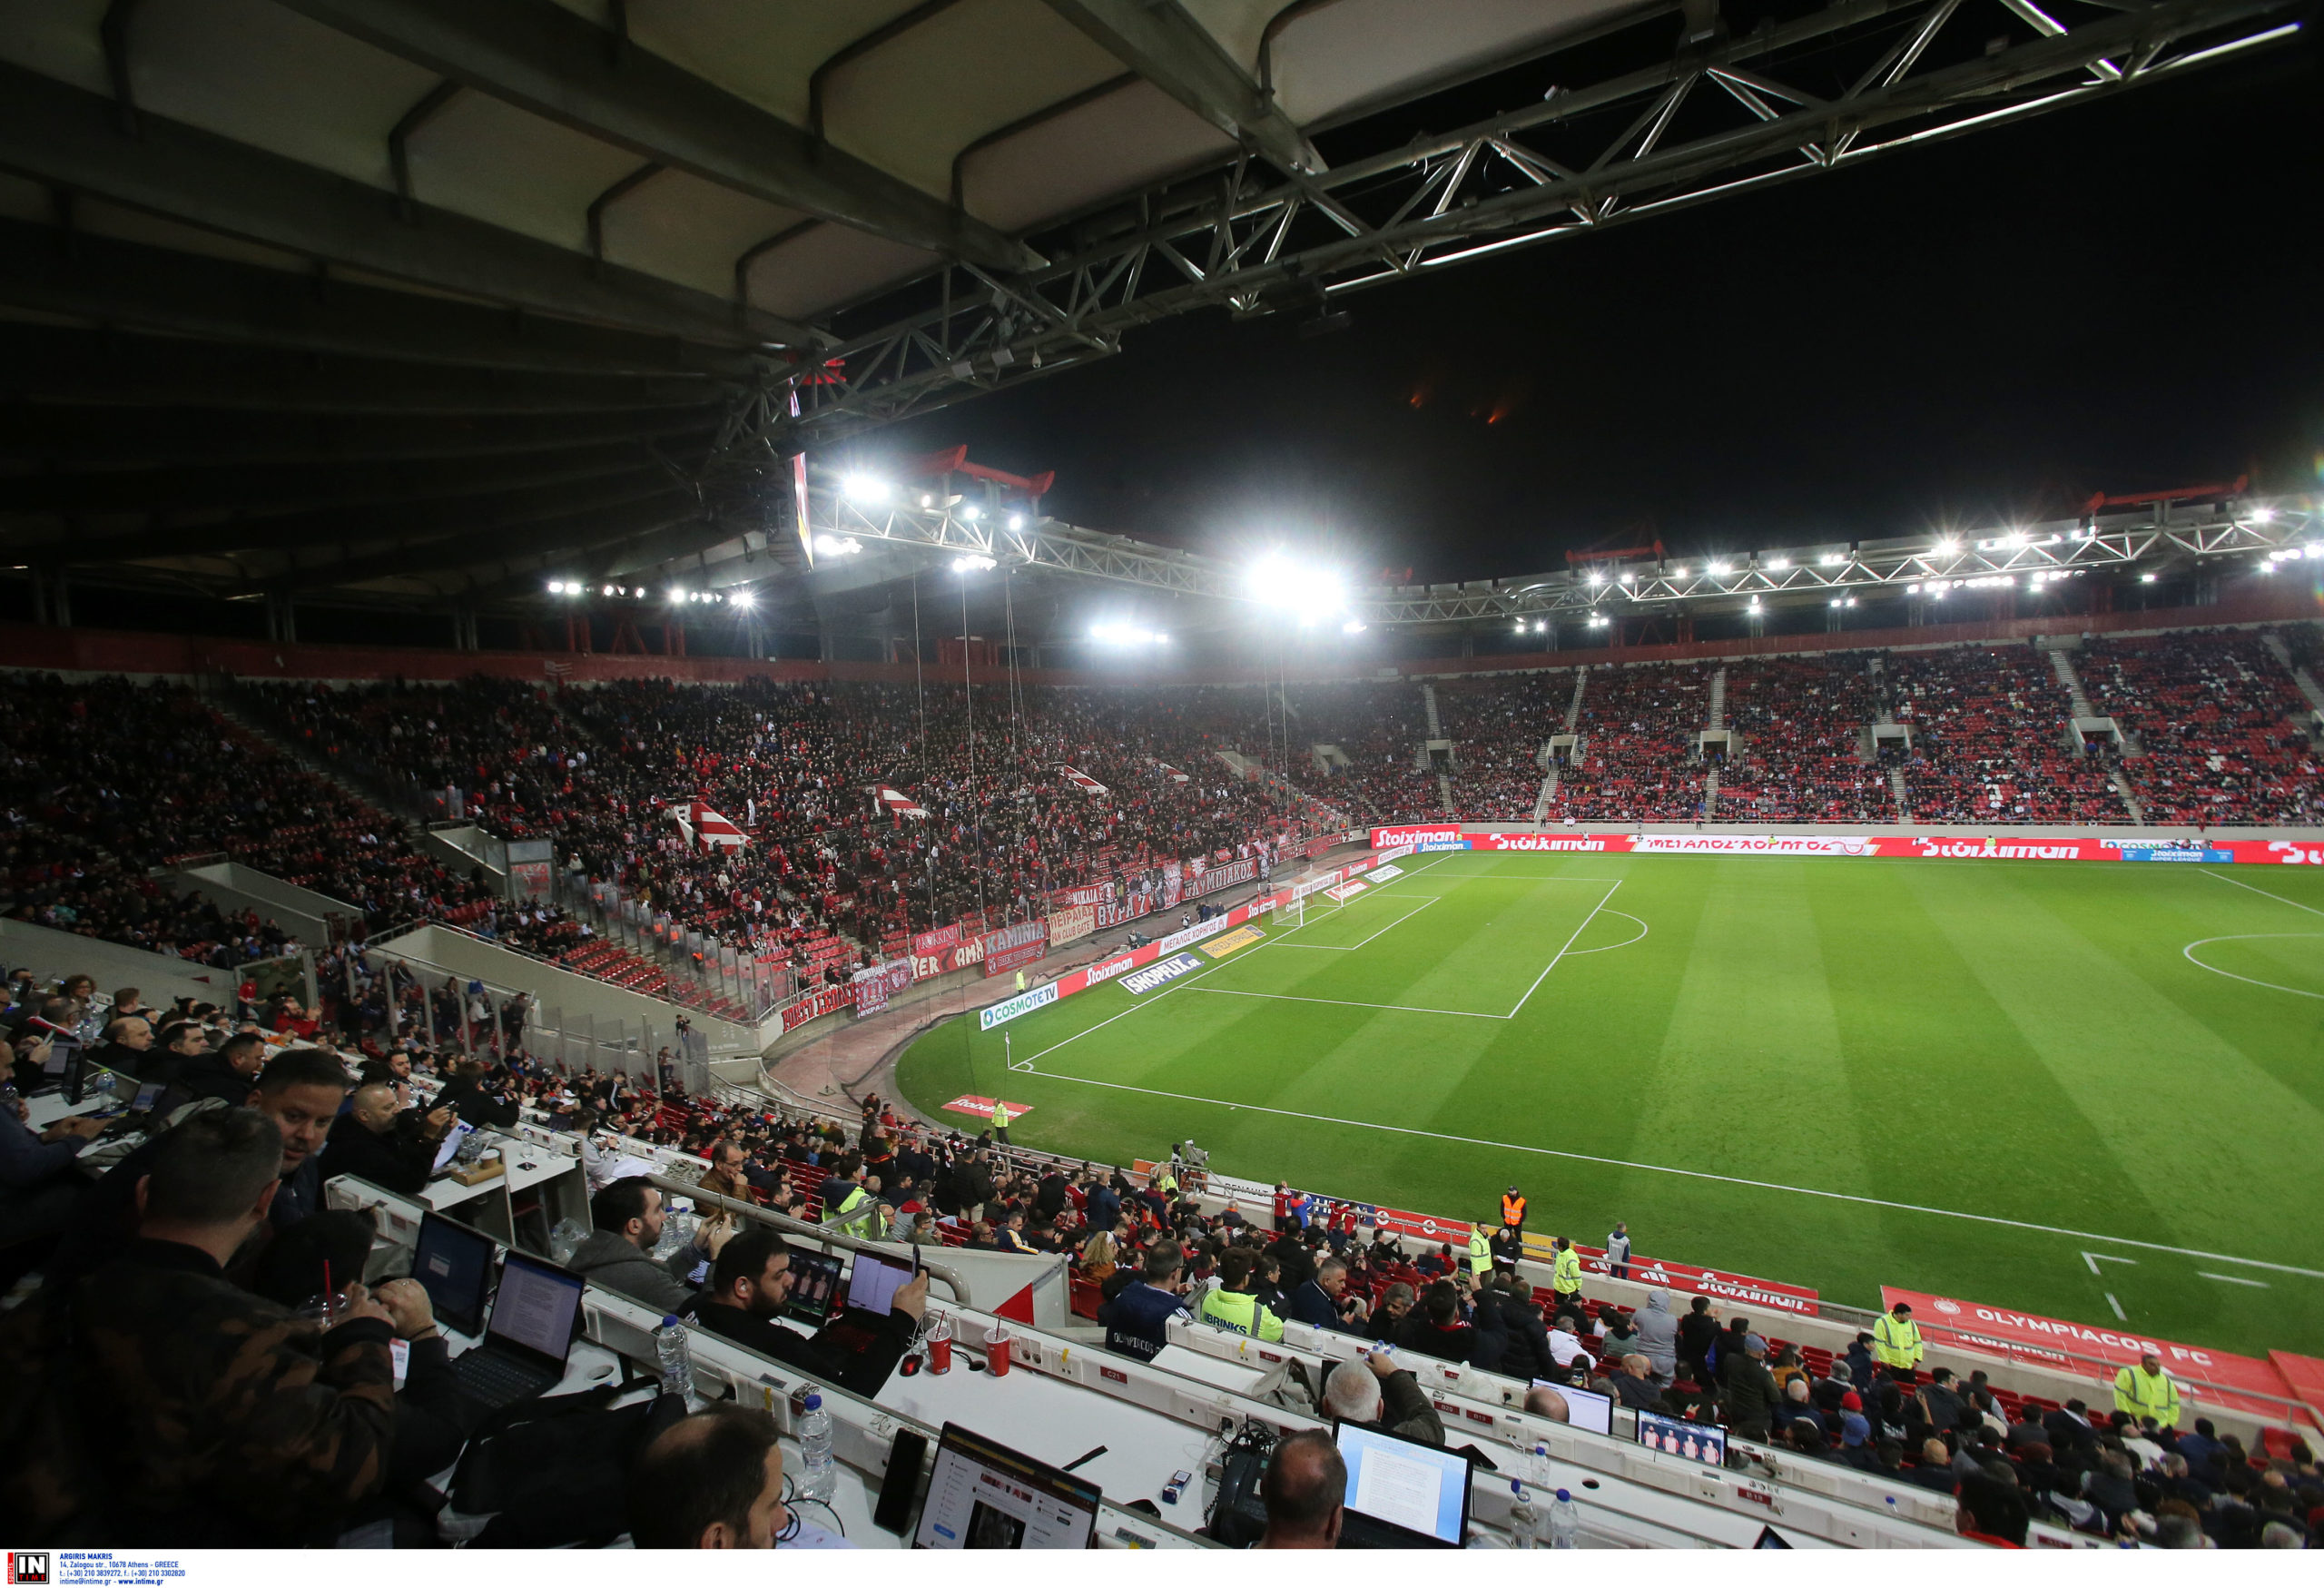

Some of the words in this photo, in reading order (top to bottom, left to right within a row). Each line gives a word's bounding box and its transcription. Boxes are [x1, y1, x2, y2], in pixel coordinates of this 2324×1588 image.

[1376, 830, 1455, 847] Stoiximan
[1422, 843, 1463, 852] Stoiximan
[986, 922, 1045, 955] KAMINIA
[1062, 925, 1077, 939] CLUB
[1164, 931, 1193, 952] ΜΕΓΑΛΟΣ
[1192, 922, 1217, 940] ΧΟΡΗΓΟΣ
[1086, 957, 1133, 987] Stoiximan
[995, 991, 1044, 1021] COSMOTE
[1044, 985, 1055, 1001] TV
[1205, 1312, 1247, 1335] BRINKS
[1976, 1308, 2162, 1355] OLYMPIACOS
[2169, 1346, 2212, 1366] FC
[1107, 1370, 1120, 1380] C21
